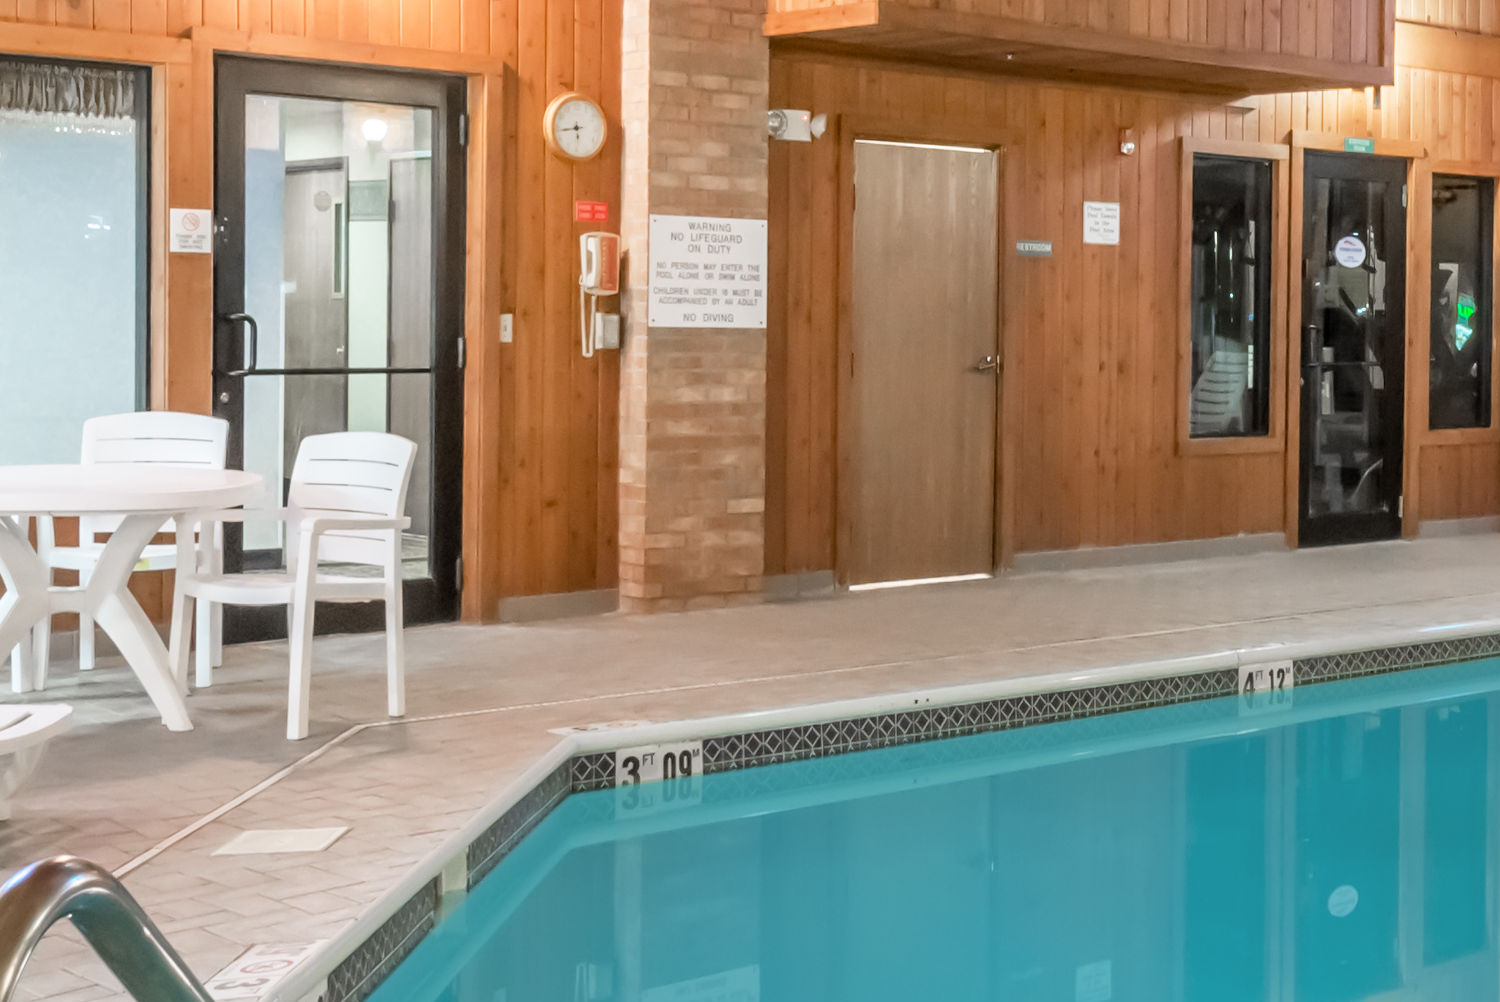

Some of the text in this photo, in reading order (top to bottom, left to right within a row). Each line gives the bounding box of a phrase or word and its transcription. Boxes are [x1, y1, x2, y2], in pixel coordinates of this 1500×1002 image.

[688, 222, 732, 233] WARNING
[670, 232, 743, 244] NO LIFEGUARD
[687, 244, 731, 254] ON DUTY
[656, 261, 667, 269] NO
[682, 313, 734, 323] NO DIVING
